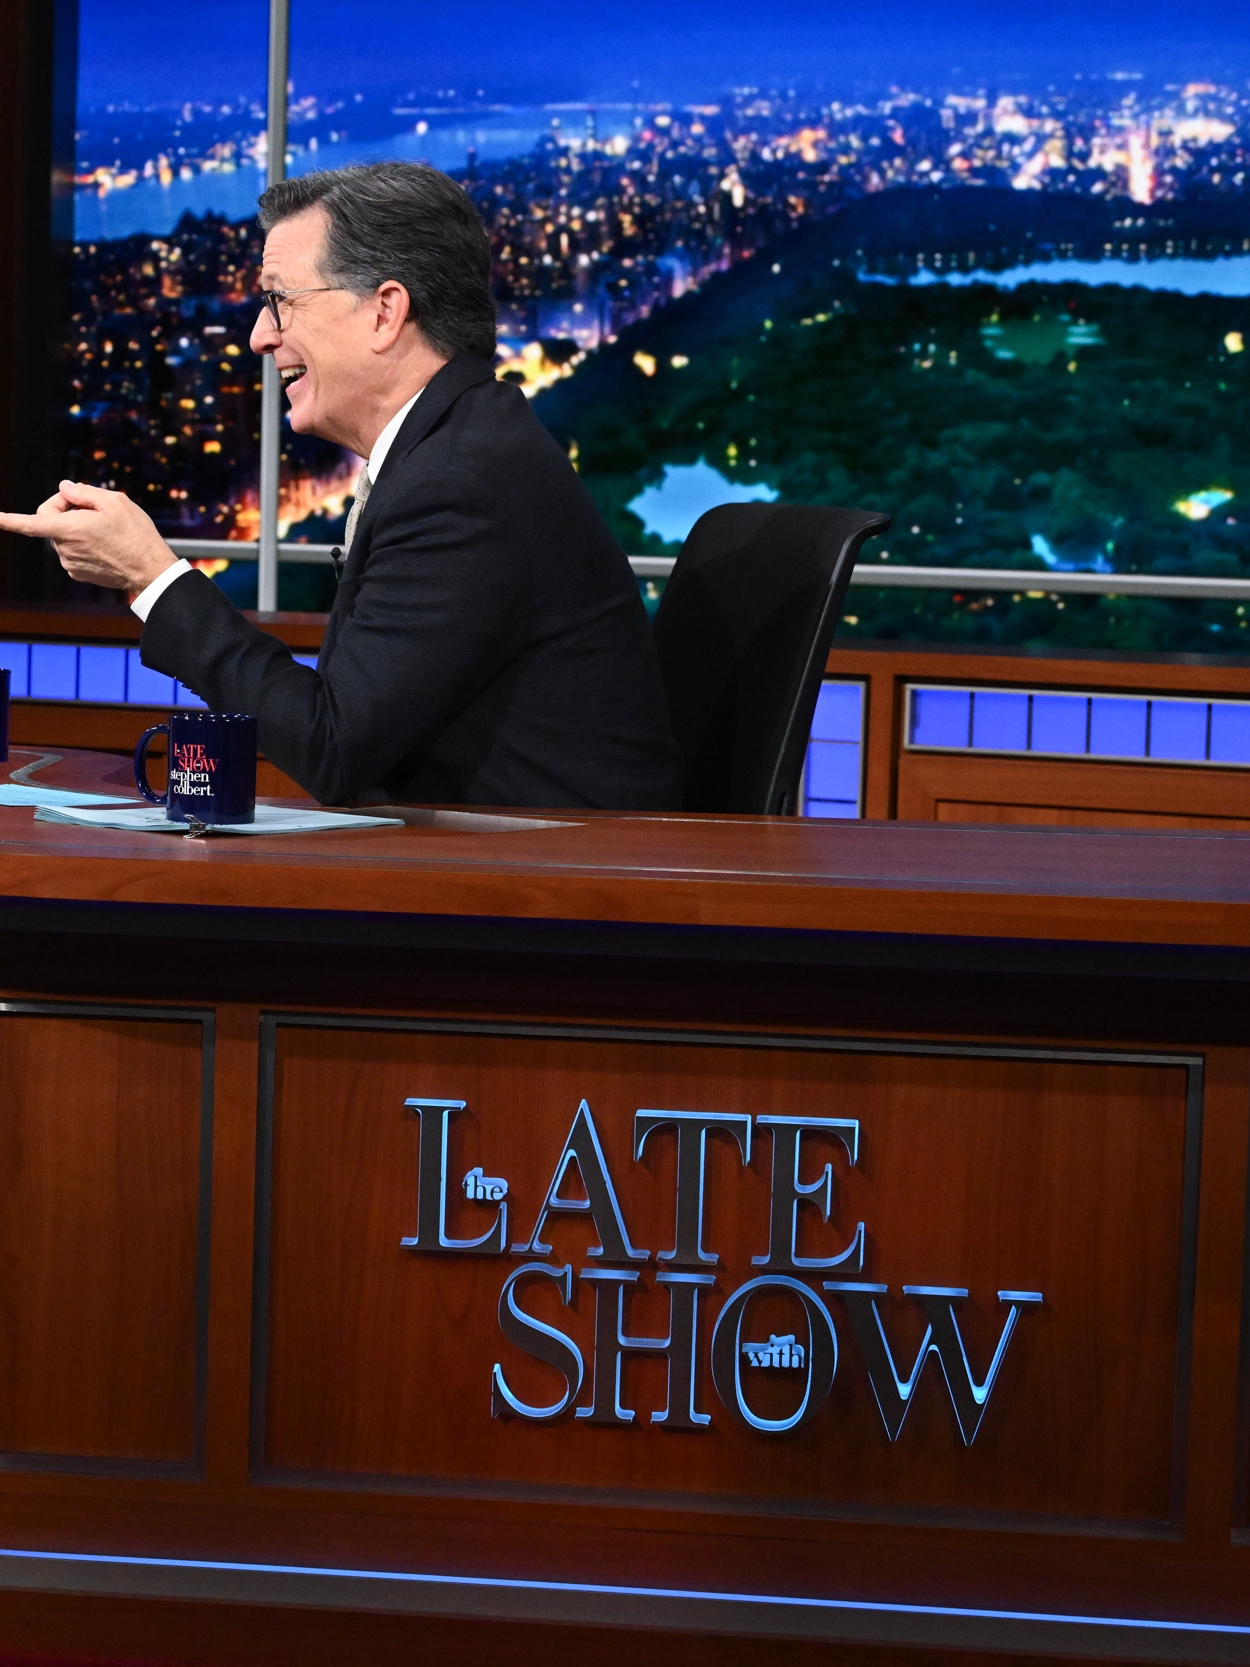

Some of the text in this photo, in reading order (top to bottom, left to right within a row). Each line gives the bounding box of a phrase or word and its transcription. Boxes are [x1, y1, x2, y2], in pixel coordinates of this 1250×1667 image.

[173, 743, 206, 759] LATE
[178, 757, 220, 772] SHOW
[170, 766, 210, 786] stephen
[400, 1097, 865, 1274] LATE
[462, 1170, 507, 1201] the
[490, 1261, 1043, 1447] SHOW
[743, 1337, 805, 1368] with
